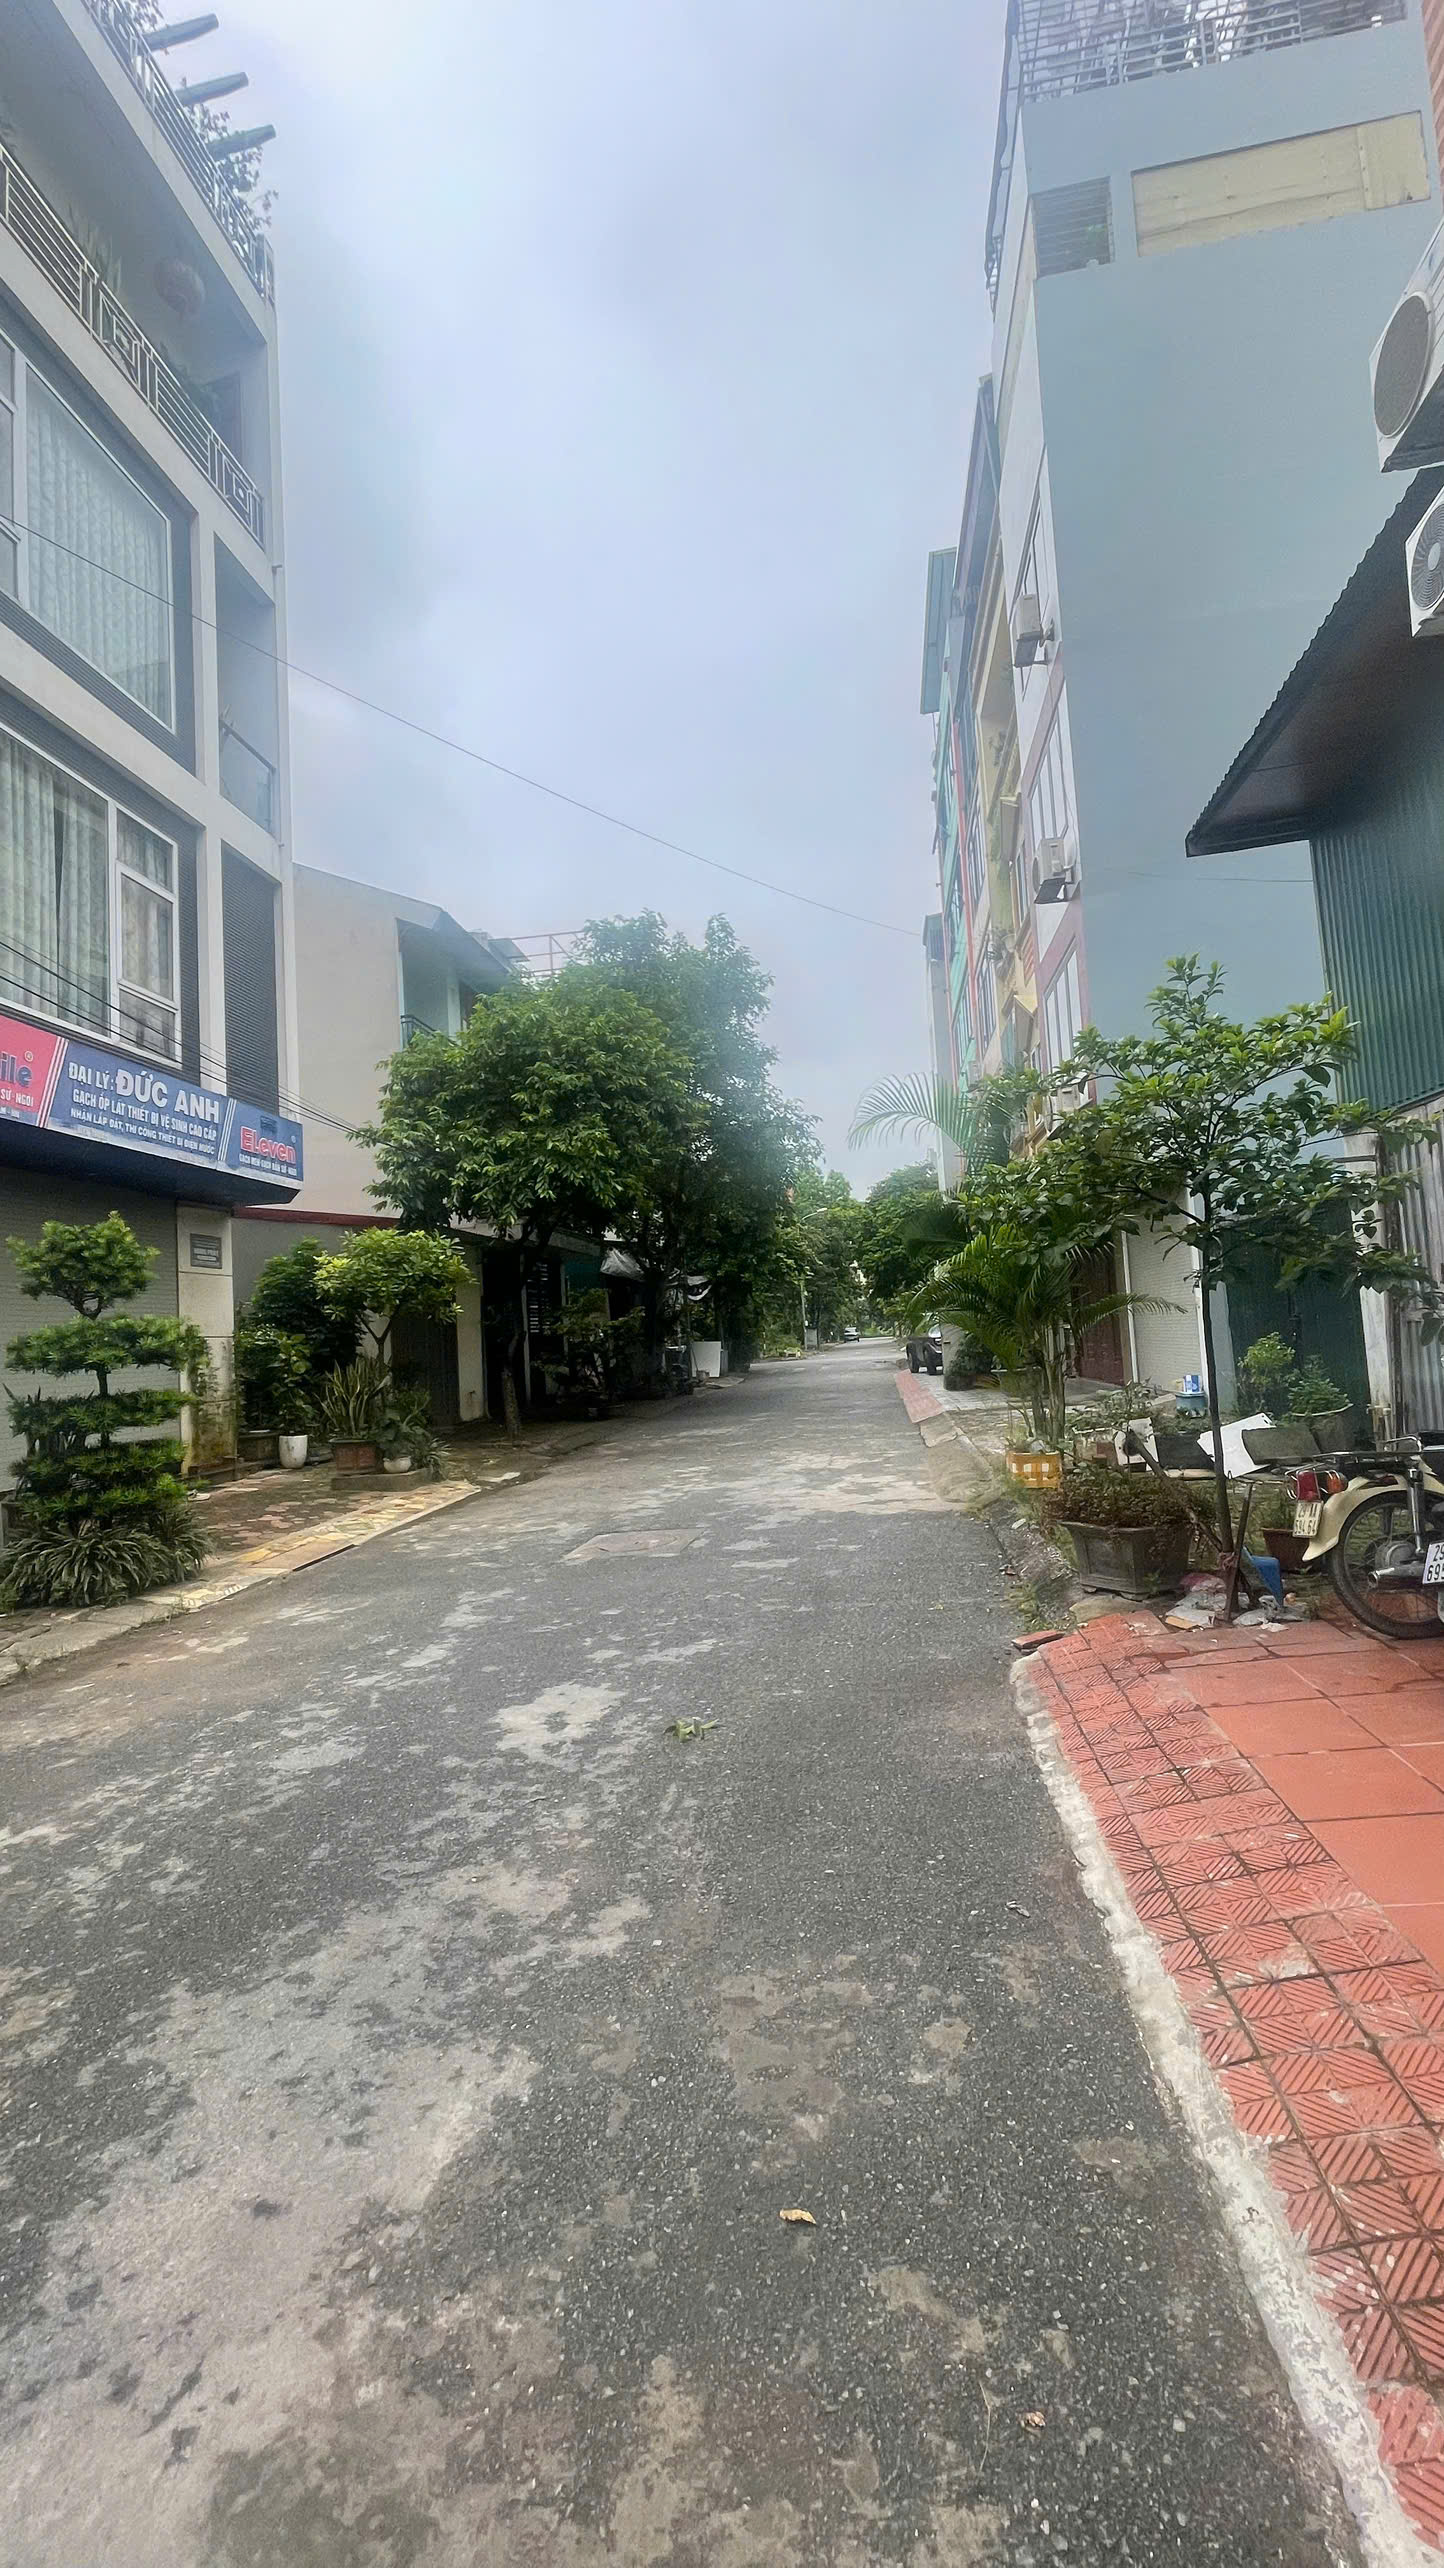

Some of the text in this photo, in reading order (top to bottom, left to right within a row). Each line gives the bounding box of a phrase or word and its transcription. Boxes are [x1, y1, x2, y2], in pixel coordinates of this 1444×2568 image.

[68, 1062, 92, 1085] ĐẠI
[115, 1068, 168, 1108] ĐỨC
[174, 1089, 219, 1124] ANH
[72, 1088, 97, 1108] GẠCH
[127, 1104, 150, 1122] THIẾT
[171, 1117, 188, 1133] SINH
